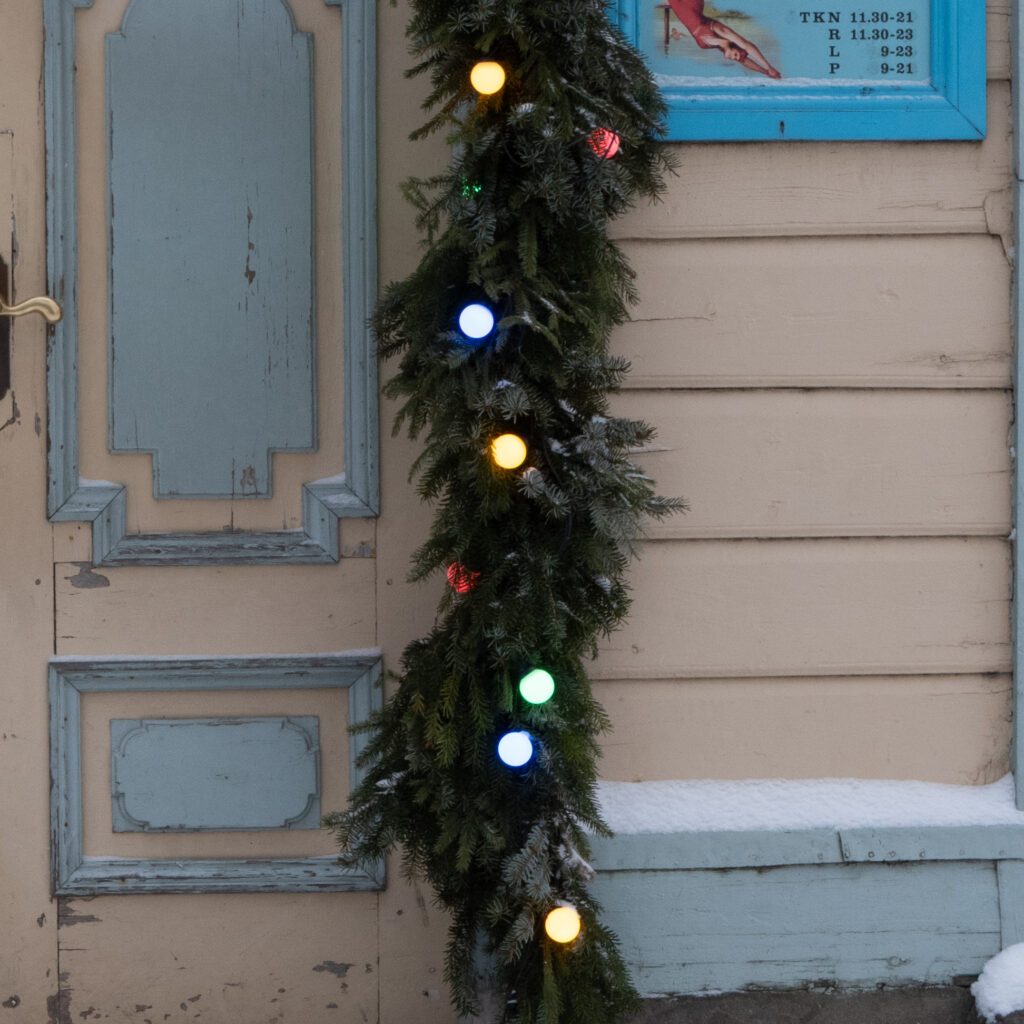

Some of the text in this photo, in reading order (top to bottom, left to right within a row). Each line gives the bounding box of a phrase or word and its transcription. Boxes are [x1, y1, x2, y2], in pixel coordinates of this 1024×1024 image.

[850, 11, 914, 23] 11.30-21
[828, 29, 914, 40] R 11.30-23
[829, 46, 914, 57] L 9-23
[829, 63, 914, 74] P 9-21
